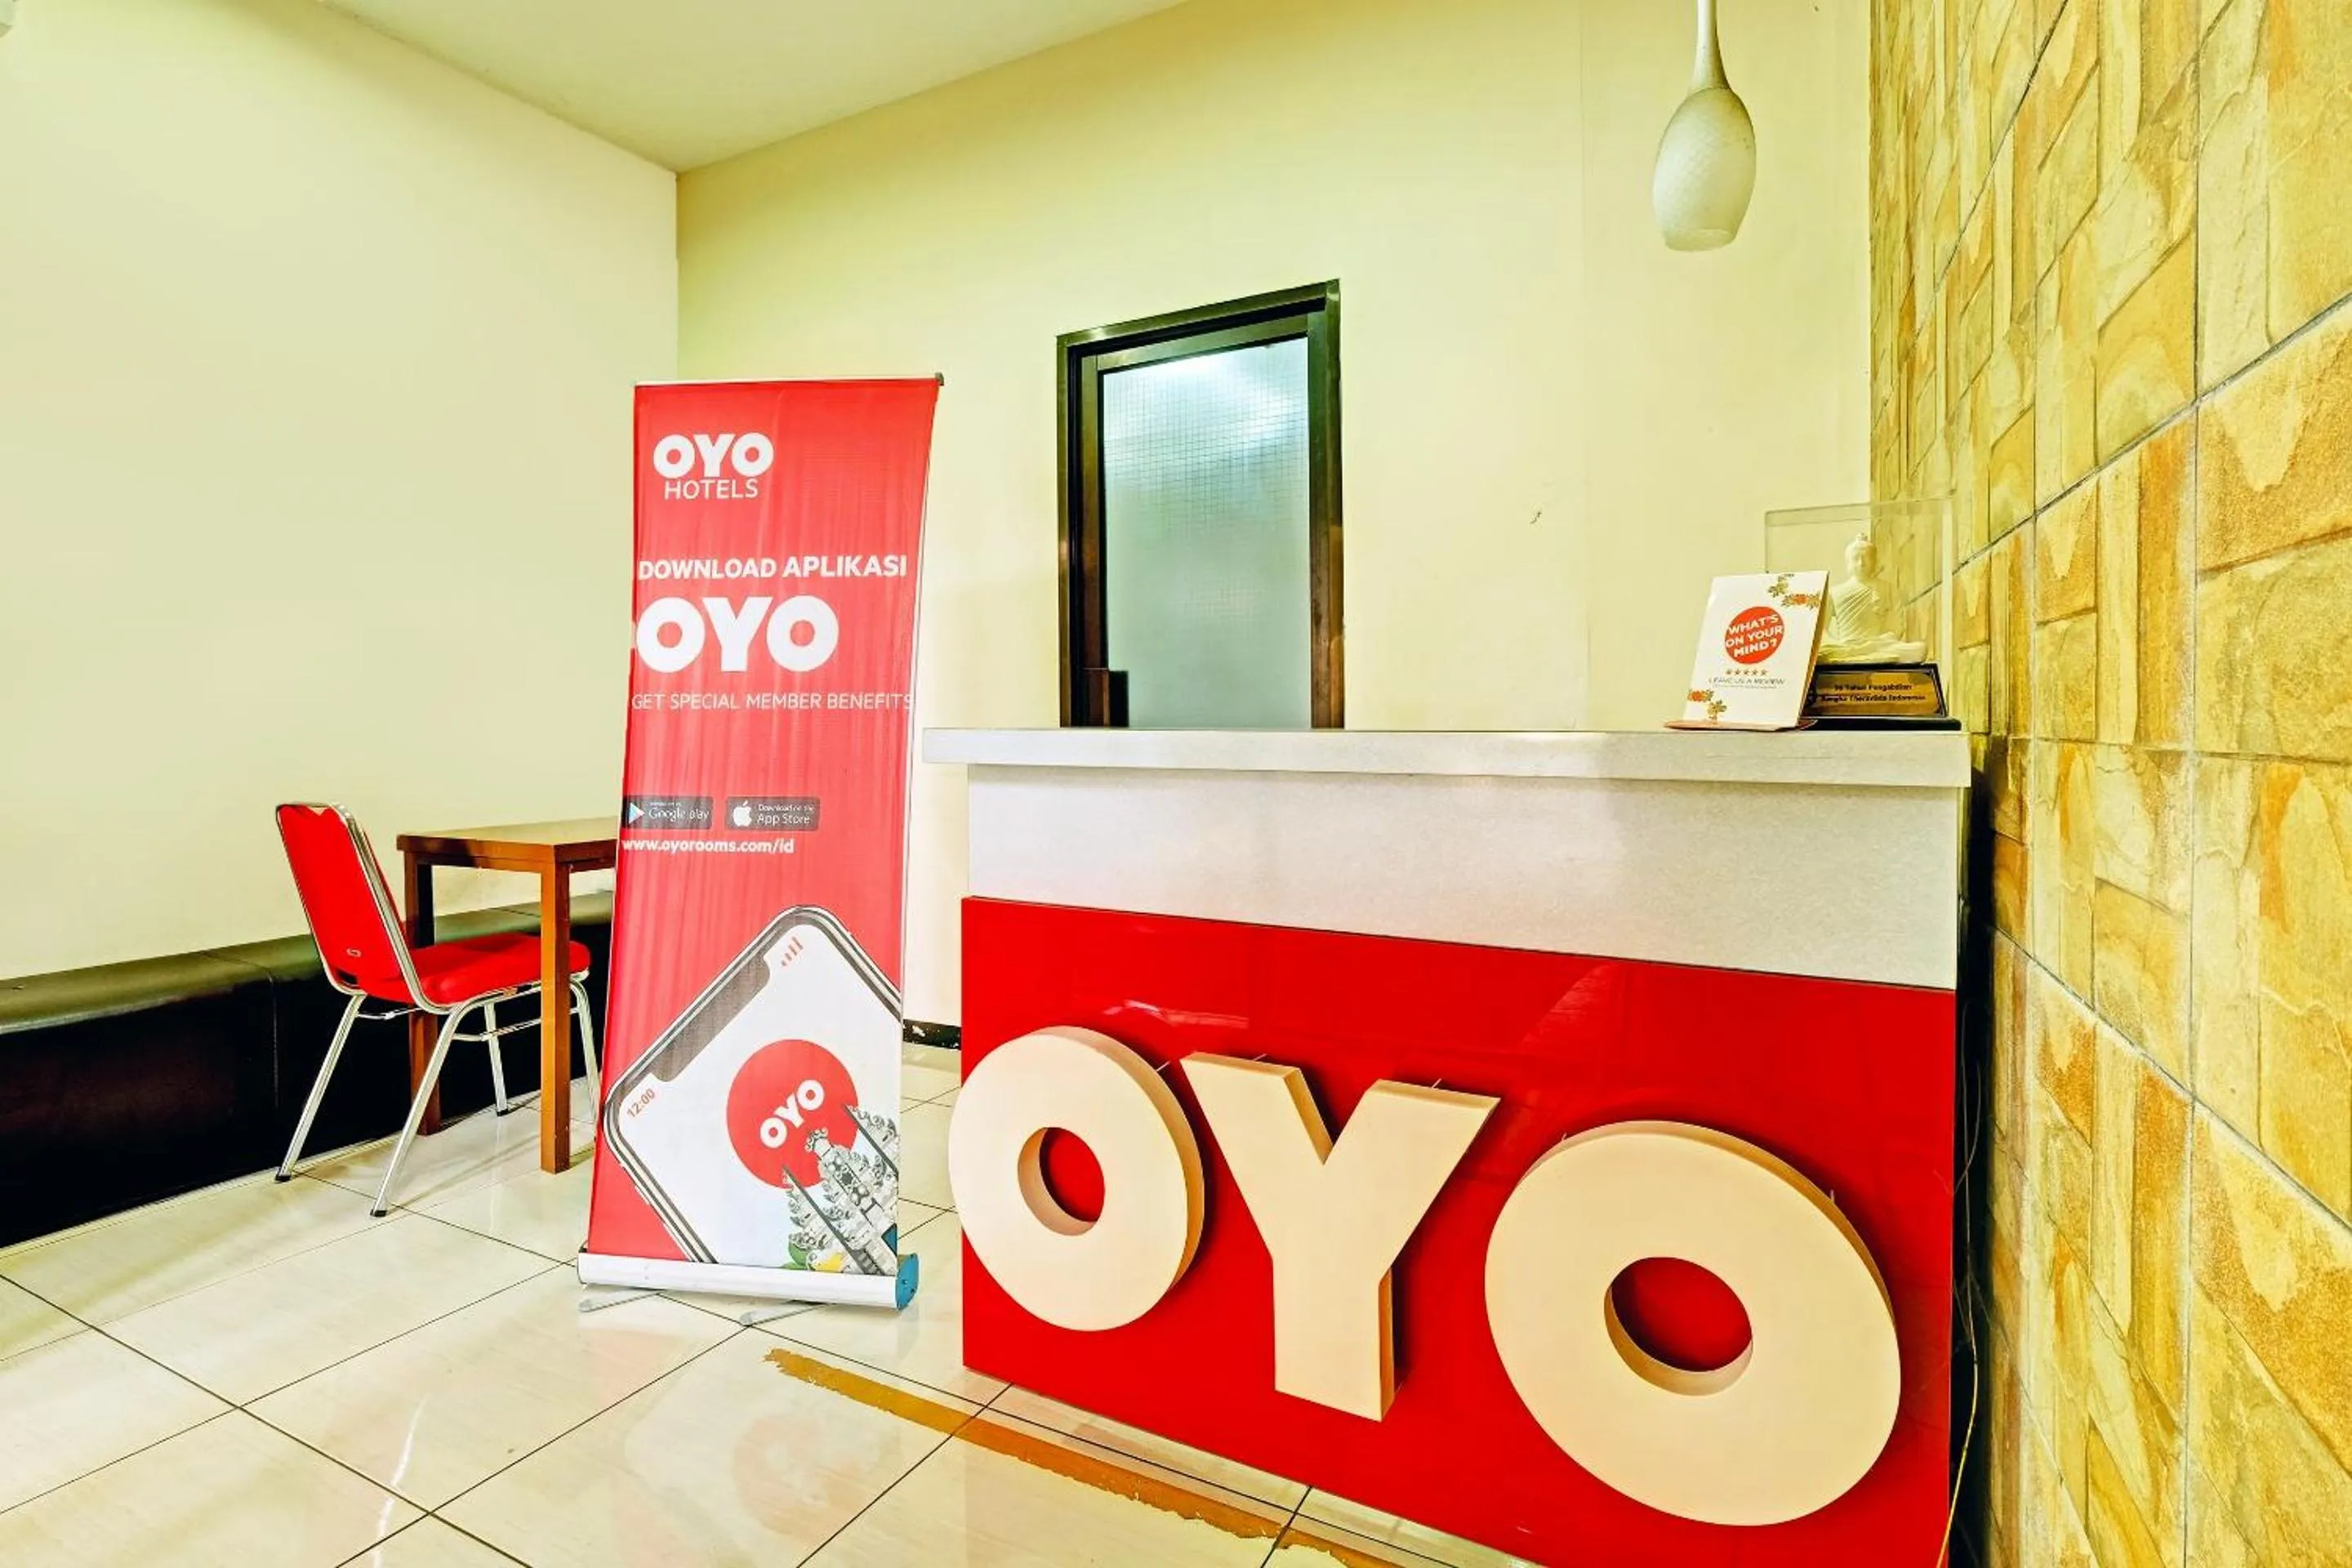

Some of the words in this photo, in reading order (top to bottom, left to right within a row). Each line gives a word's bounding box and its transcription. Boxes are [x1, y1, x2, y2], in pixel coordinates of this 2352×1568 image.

[653, 432, 774, 479] OYO
[664, 478, 759, 501] HOTELS
[639, 557, 777, 581] DOWNLOAD
[782, 555, 907, 579] APLIKASI
[635, 595, 840, 674] OYO
[1728, 613, 1779, 635] WHAT'S
[1725, 635, 1744, 648] ON
[1747, 625, 1784, 642] YOUR
[630, 693, 665, 710] GET
[670, 693, 739, 710] SPECIAL
[746, 692, 822, 710] MEMBER
[826, 692, 912, 710] BENEFITS
[757, 813, 780, 826] App
[782, 813, 810, 824] Store
[621, 838, 795, 854] www.oyorooms.com/id
[626, 1087, 657, 1119] 12:00
[760, 1079, 825, 1148] OYO
[948, 1025, 1902, 1526] OYO
